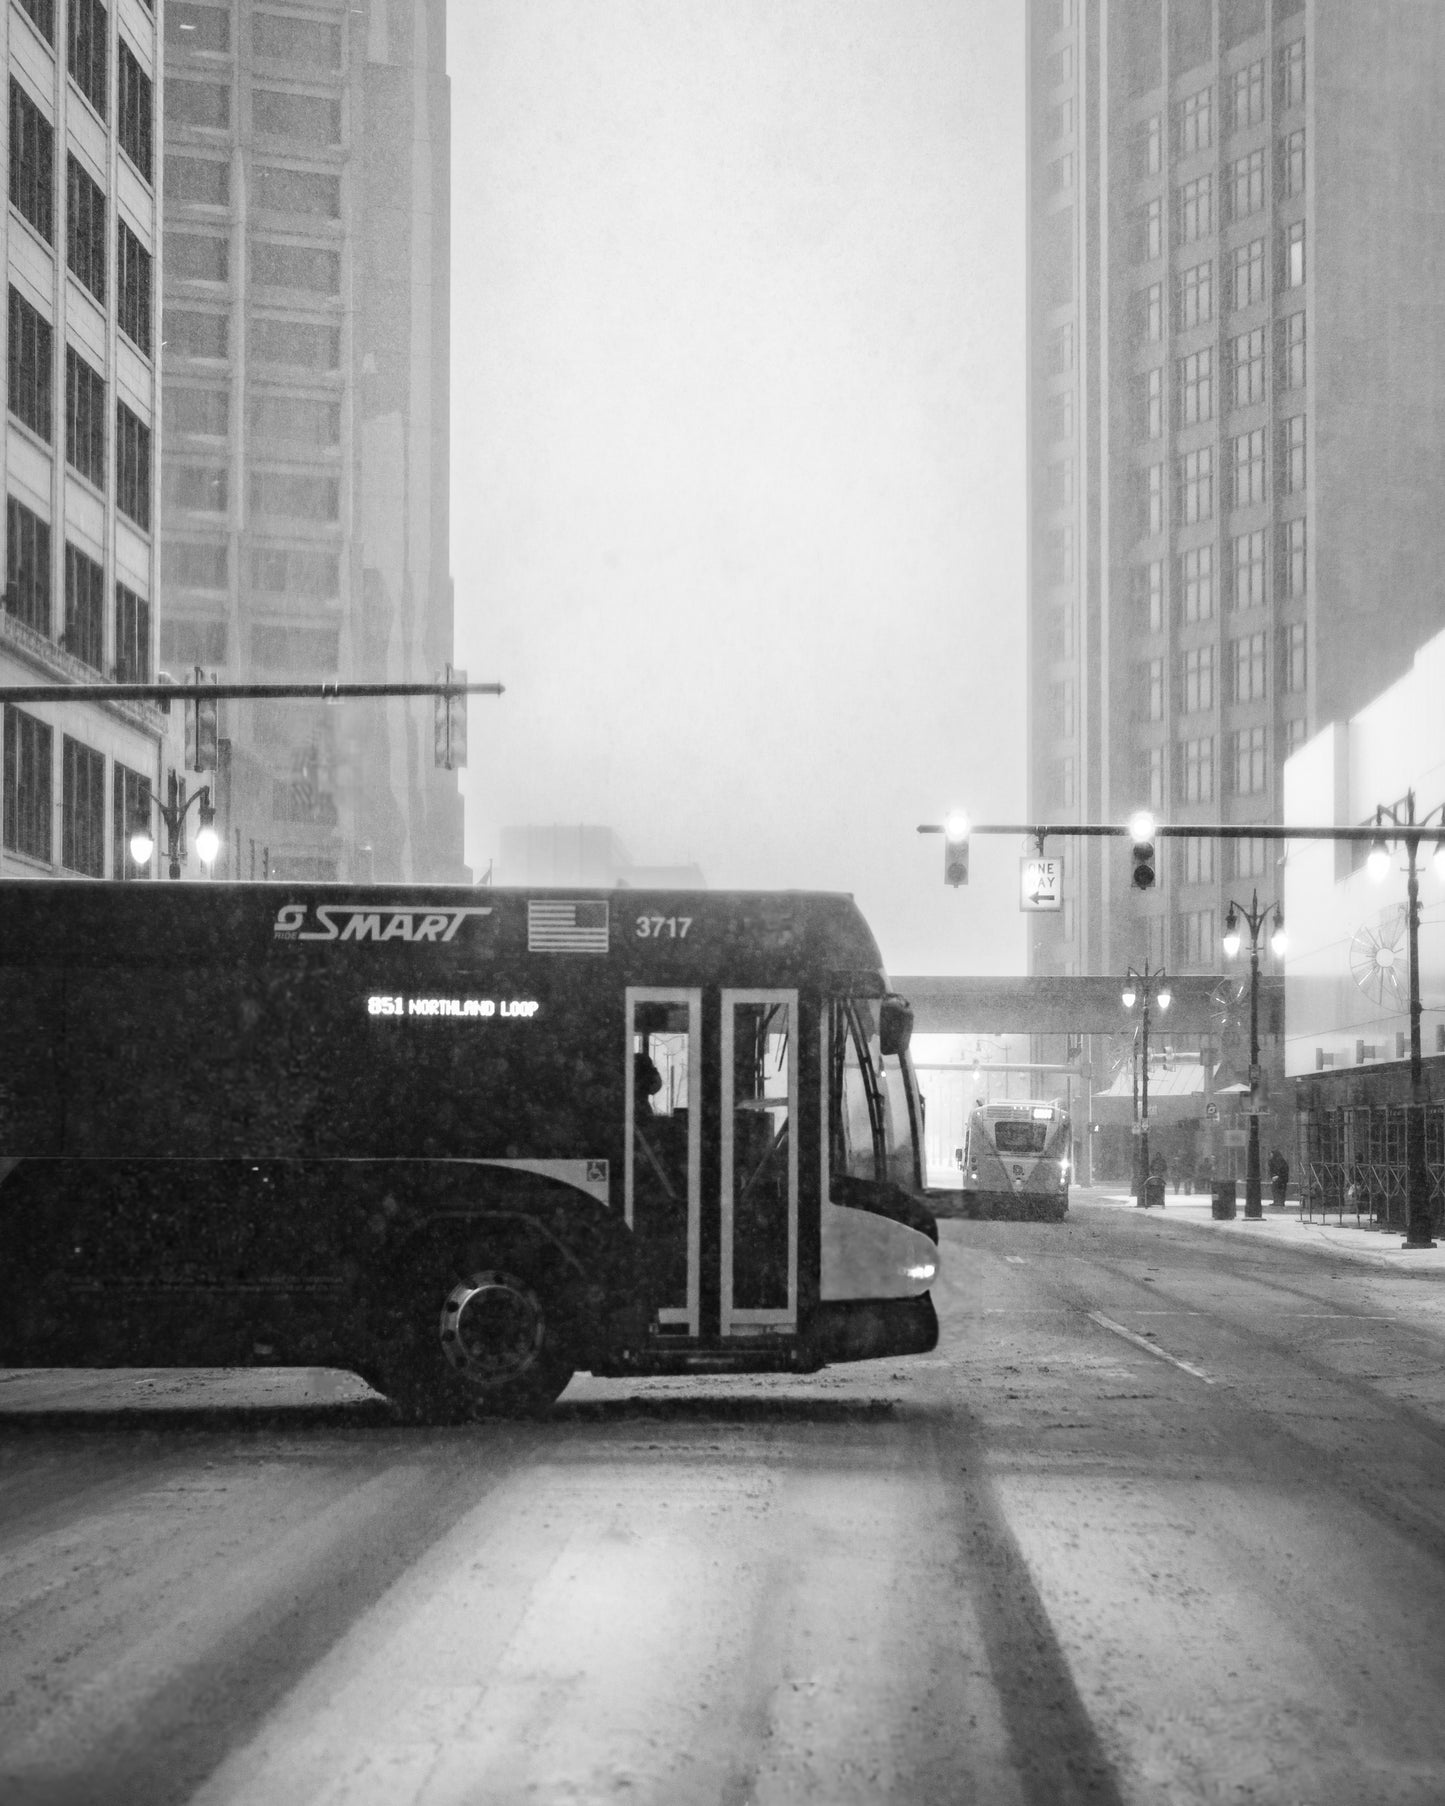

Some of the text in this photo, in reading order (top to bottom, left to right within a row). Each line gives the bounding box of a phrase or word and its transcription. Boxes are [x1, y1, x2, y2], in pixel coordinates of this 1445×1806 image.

[1031, 876, 1056, 889] AY
[298, 905, 493, 942] SMART
[636, 916, 693, 938] 3717
[274, 931, 298, 940] RIDE
[367, 996, 539, 1017] 851 NORTHLAND LOOP
